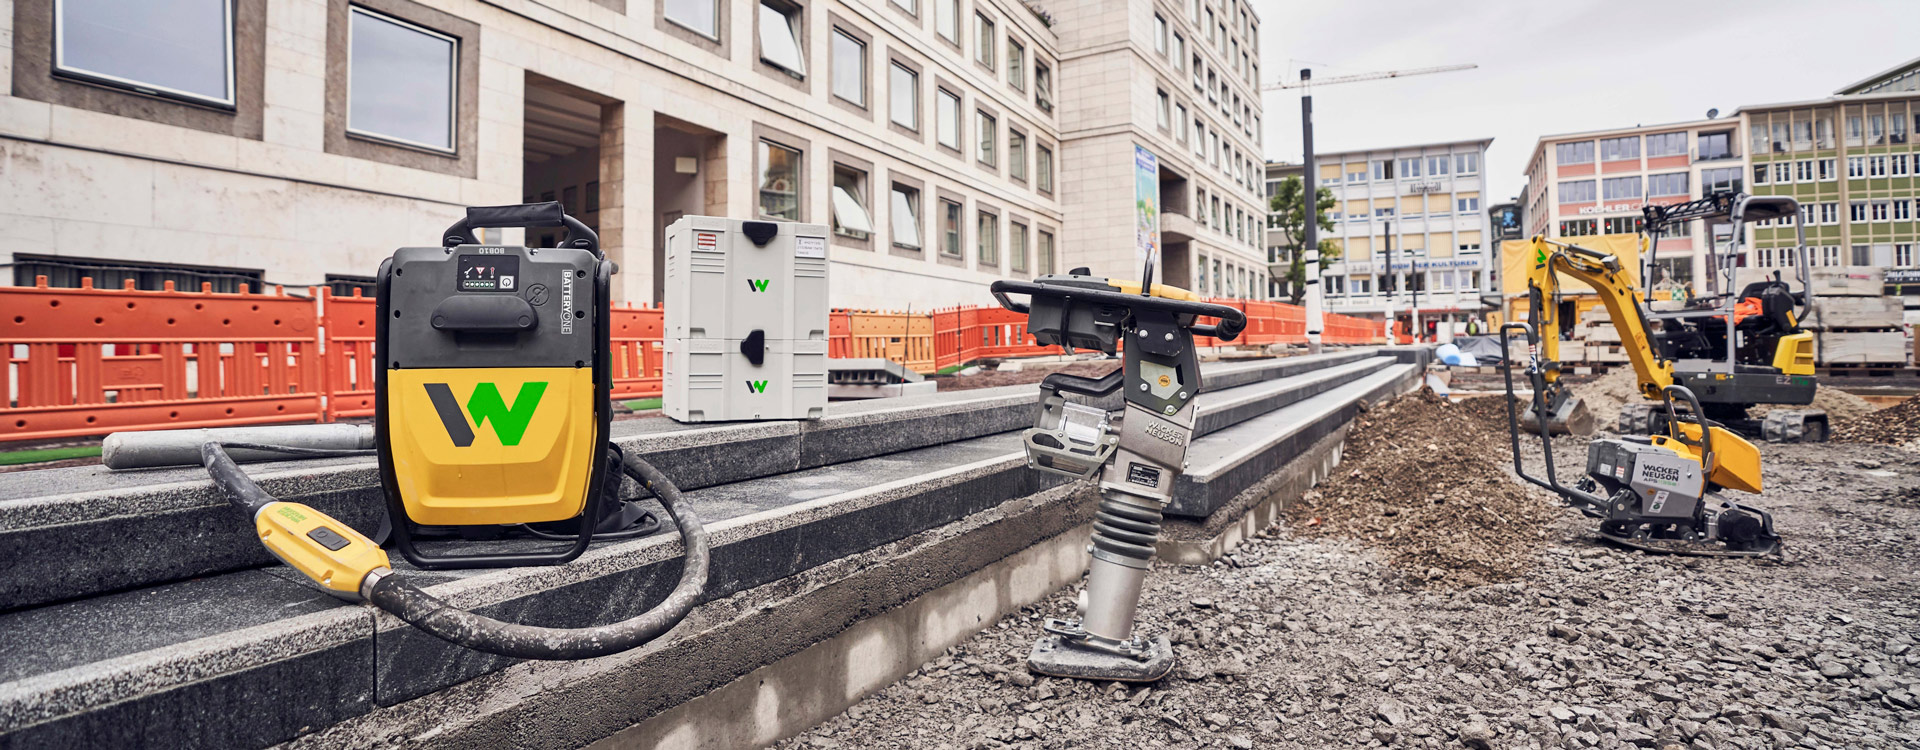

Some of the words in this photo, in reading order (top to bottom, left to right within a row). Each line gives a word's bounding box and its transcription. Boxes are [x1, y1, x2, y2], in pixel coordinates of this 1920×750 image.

[1431, 260, 1478, 268] KULTUREN
[422, 381, 549, 448] W
[1144, 425, 1184, 447] NEUSON
[1148, 420, 1185, 440] WACKER
[1642, 470, 1679, 482] NEUSON
[1643, 464, 1679, 476] WACKER
